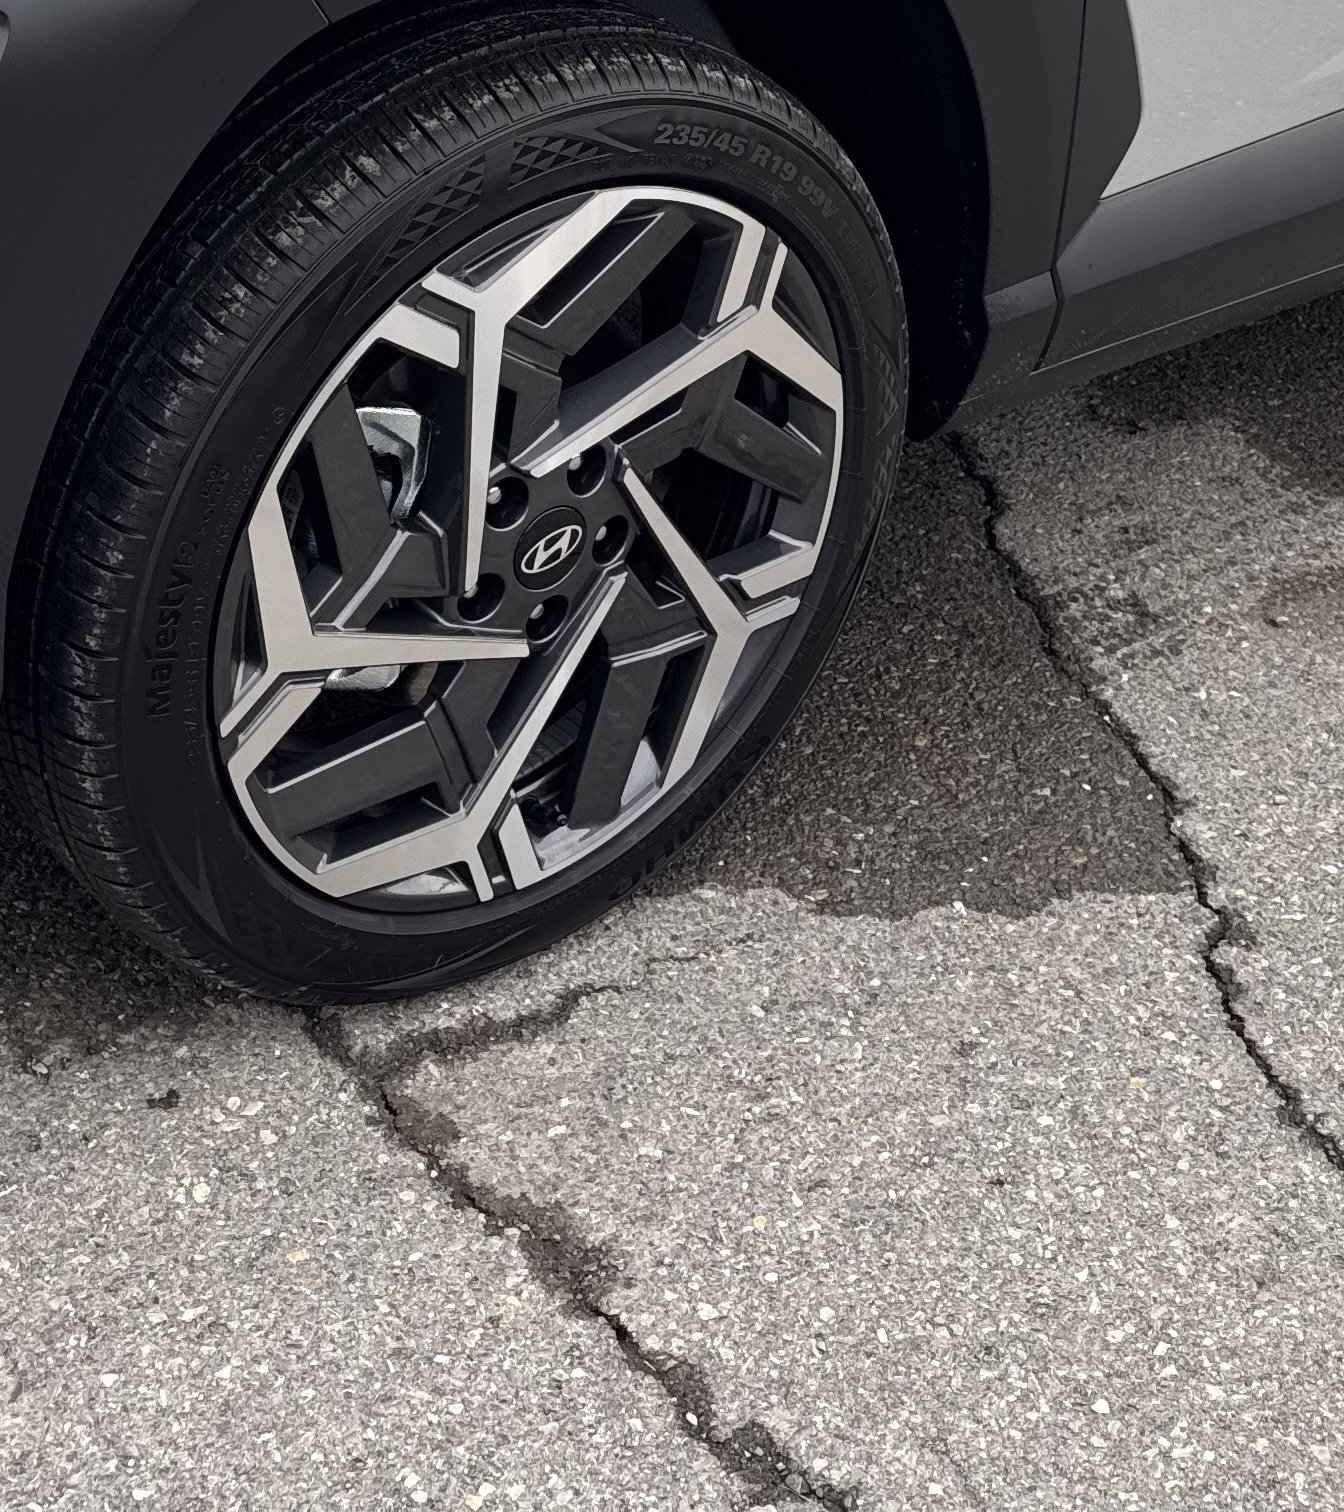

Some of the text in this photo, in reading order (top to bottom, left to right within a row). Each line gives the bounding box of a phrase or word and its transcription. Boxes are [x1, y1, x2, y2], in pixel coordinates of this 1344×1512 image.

[654, 123, 750, 157] 235/45
[750, 144, 798, 182] R19
[797, 175, 840, 218] 99V
